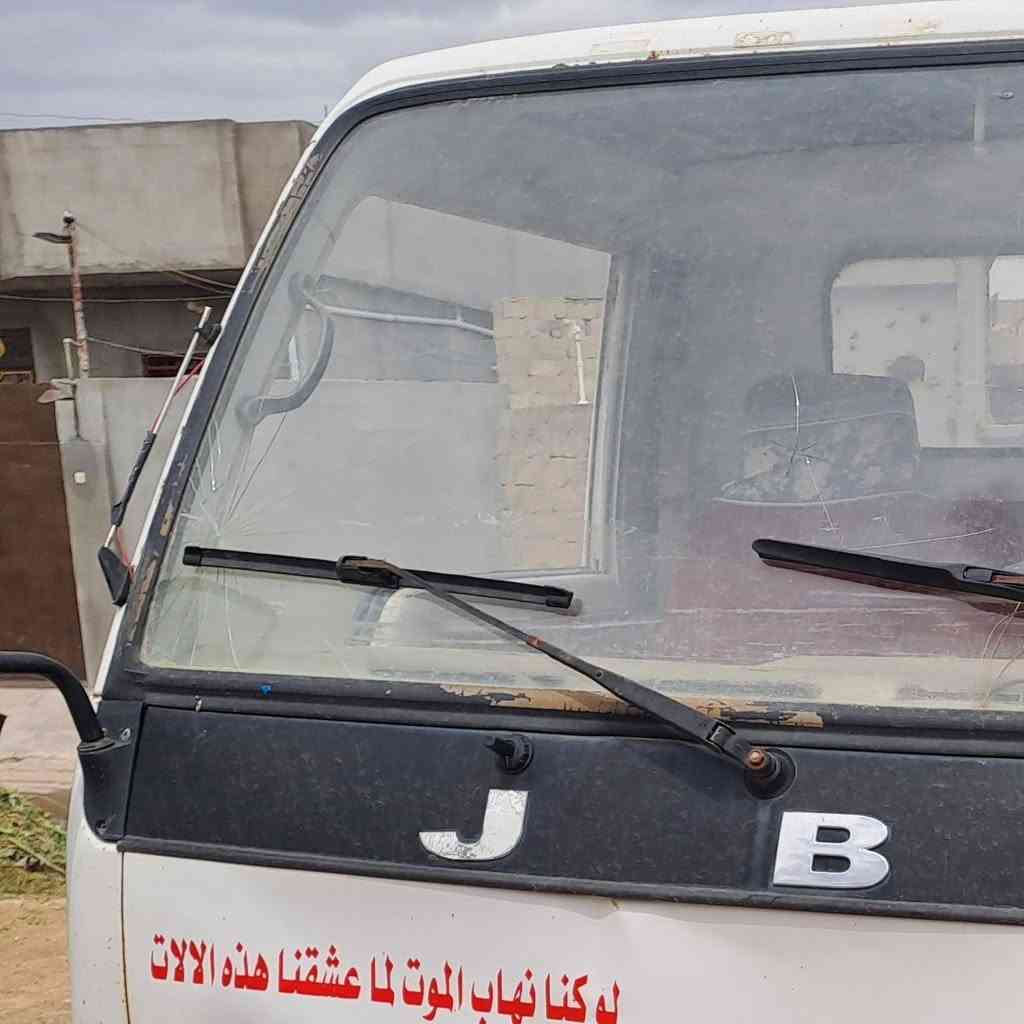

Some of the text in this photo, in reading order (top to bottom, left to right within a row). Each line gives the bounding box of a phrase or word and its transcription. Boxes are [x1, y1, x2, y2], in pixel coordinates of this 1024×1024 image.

[149, 933, 217, 988] الالات
[220, 941, 270, 993] هذه
[277, 943, 363, 1001] عشقنا
[369, 954, 396, 1008] لما
[401, 957, 465, 1023] الموت
[545, 973, 589, 1024] كنا
